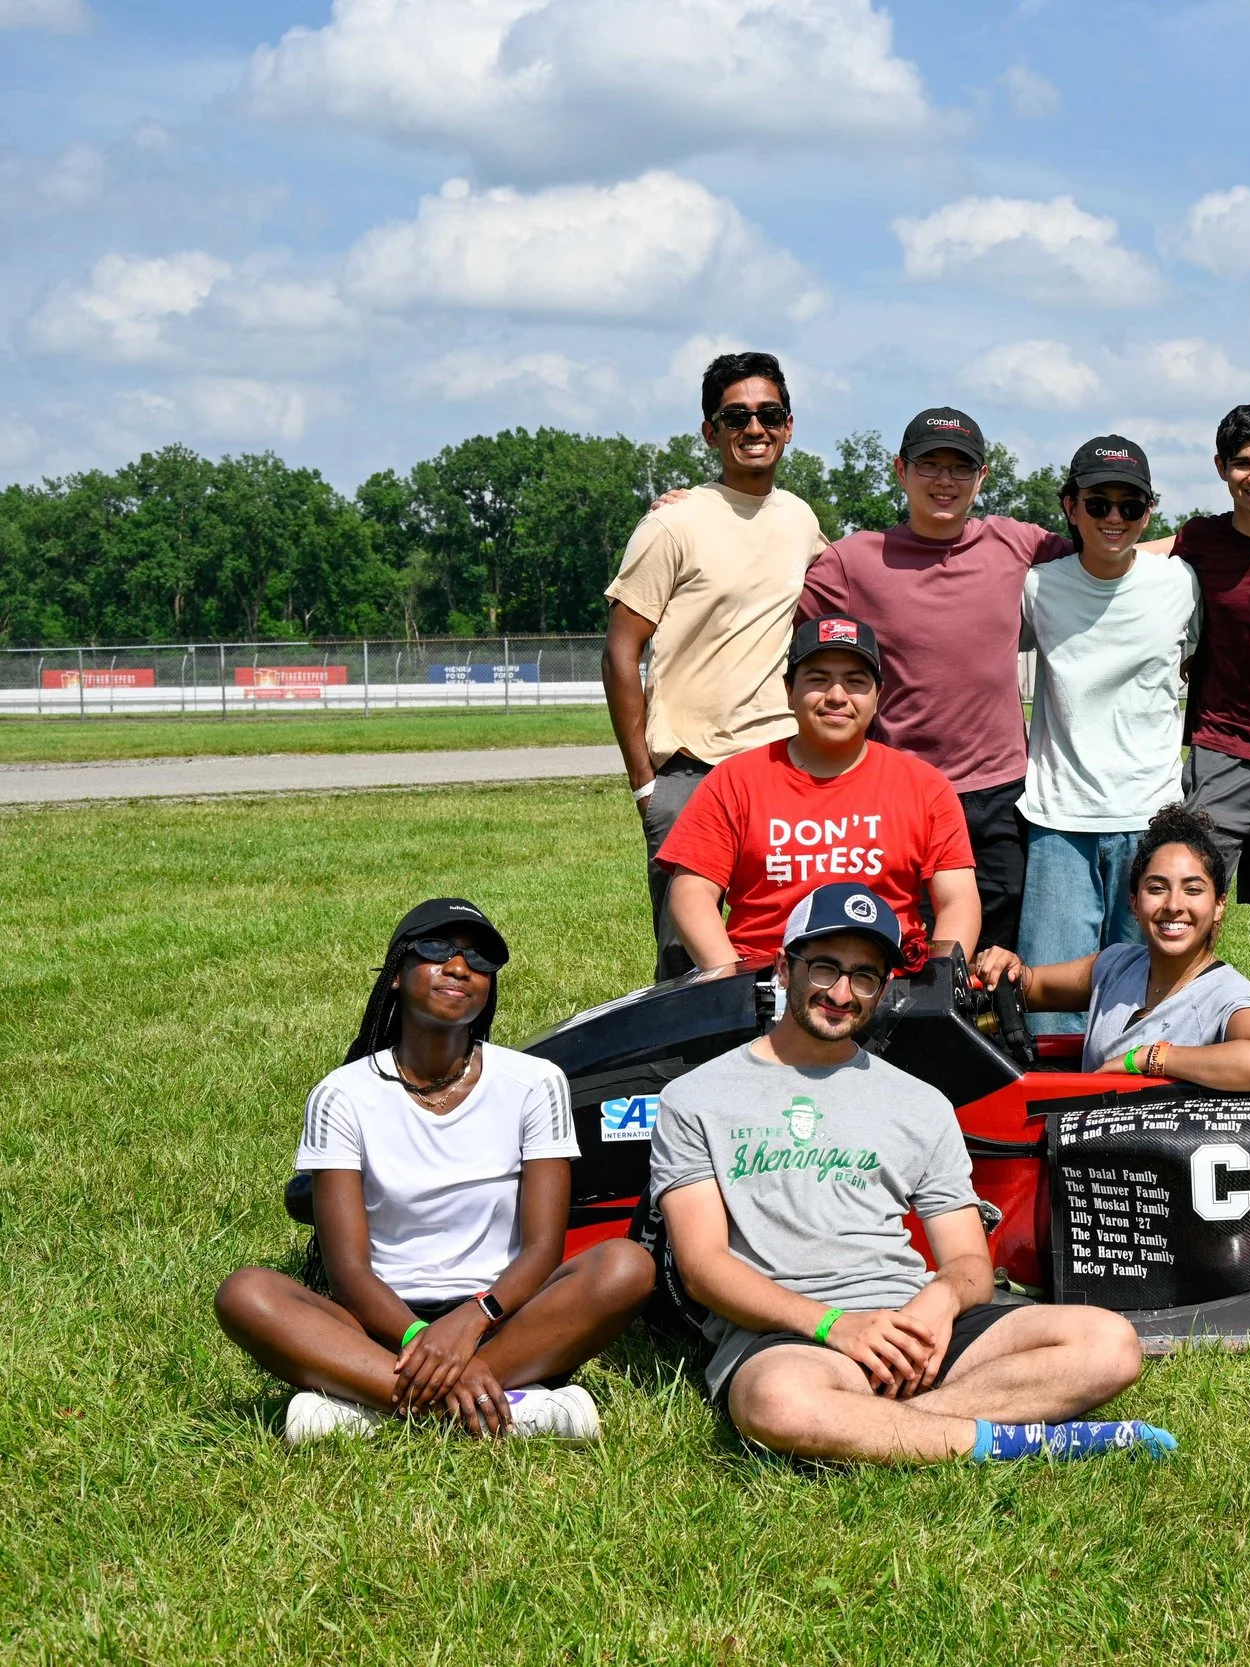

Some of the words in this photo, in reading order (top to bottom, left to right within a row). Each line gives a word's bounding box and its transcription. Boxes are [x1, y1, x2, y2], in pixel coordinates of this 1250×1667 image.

[926, 418, 960, 427] Cornell
[1095, 448, 1128, 457] Cornell
[769, 814, 881, 846] DON'T
[765, 847, 884, 887] STRESS
[603, 1097, 660, 1130] SAE
[1189, 1113, 1209, 1121] The
[730, 1127, 753, 1139] LET
[757, 1127, 783, 1138] THE
[1060, 1122, 1079, 1133] The
[1085, 1115, 1134, 1126] Sudmann
[1060, 1133, 1077, 1146] Wu
[1083, 1127, 1103, 1140] and
[1109, 1123, 1136, 1134] Zhen
[1142, 1120, 1180, 1131] Family
[1204, 1120, 1242, 1133] Family
[604, 1131, 651, 1139] INTERNATIO
[727, 1140, 881, 1185] Shenanigans
[834, 1171, 867, 1191] BEGIN
[1062, 1166, 1082, 1178] The
[1088, 1167, 1117, 1180] Dalal
[1122, 1169, 1158, 1185] Family
[1065, 1180, 1085, 1193] The
[1091, 1182, 1130, 1196] Munver
[1135, 1185, 1170, 1202] Family
[1067, 1195, 1087, 1208] The
[1093, 1197, 1130, 1212] Moskal
[1135, 1200, 1170, 1218] Family
[1070, 1211, 1093, 1226] Lilly
[1098, 1213, 1130, 1228] Varon
[1135, 1216, 1151, 1230] '27
[1071, 1227, 1091, 1241] The
[1096, 1229, 1128, 1244] Varon
[1133, 1232, 1168, 1249] Family
[1071, 1243, 1092, 1257] The
[1097, 1245, 1134, 1262] Harvey
[1140, 1248, 1175, 1265] Family
[1072, 1260, 1106, 1277] McCoy
[1112, 1263, 1148, 1279] Family
[664, 1271, 682, 1306] RACING
